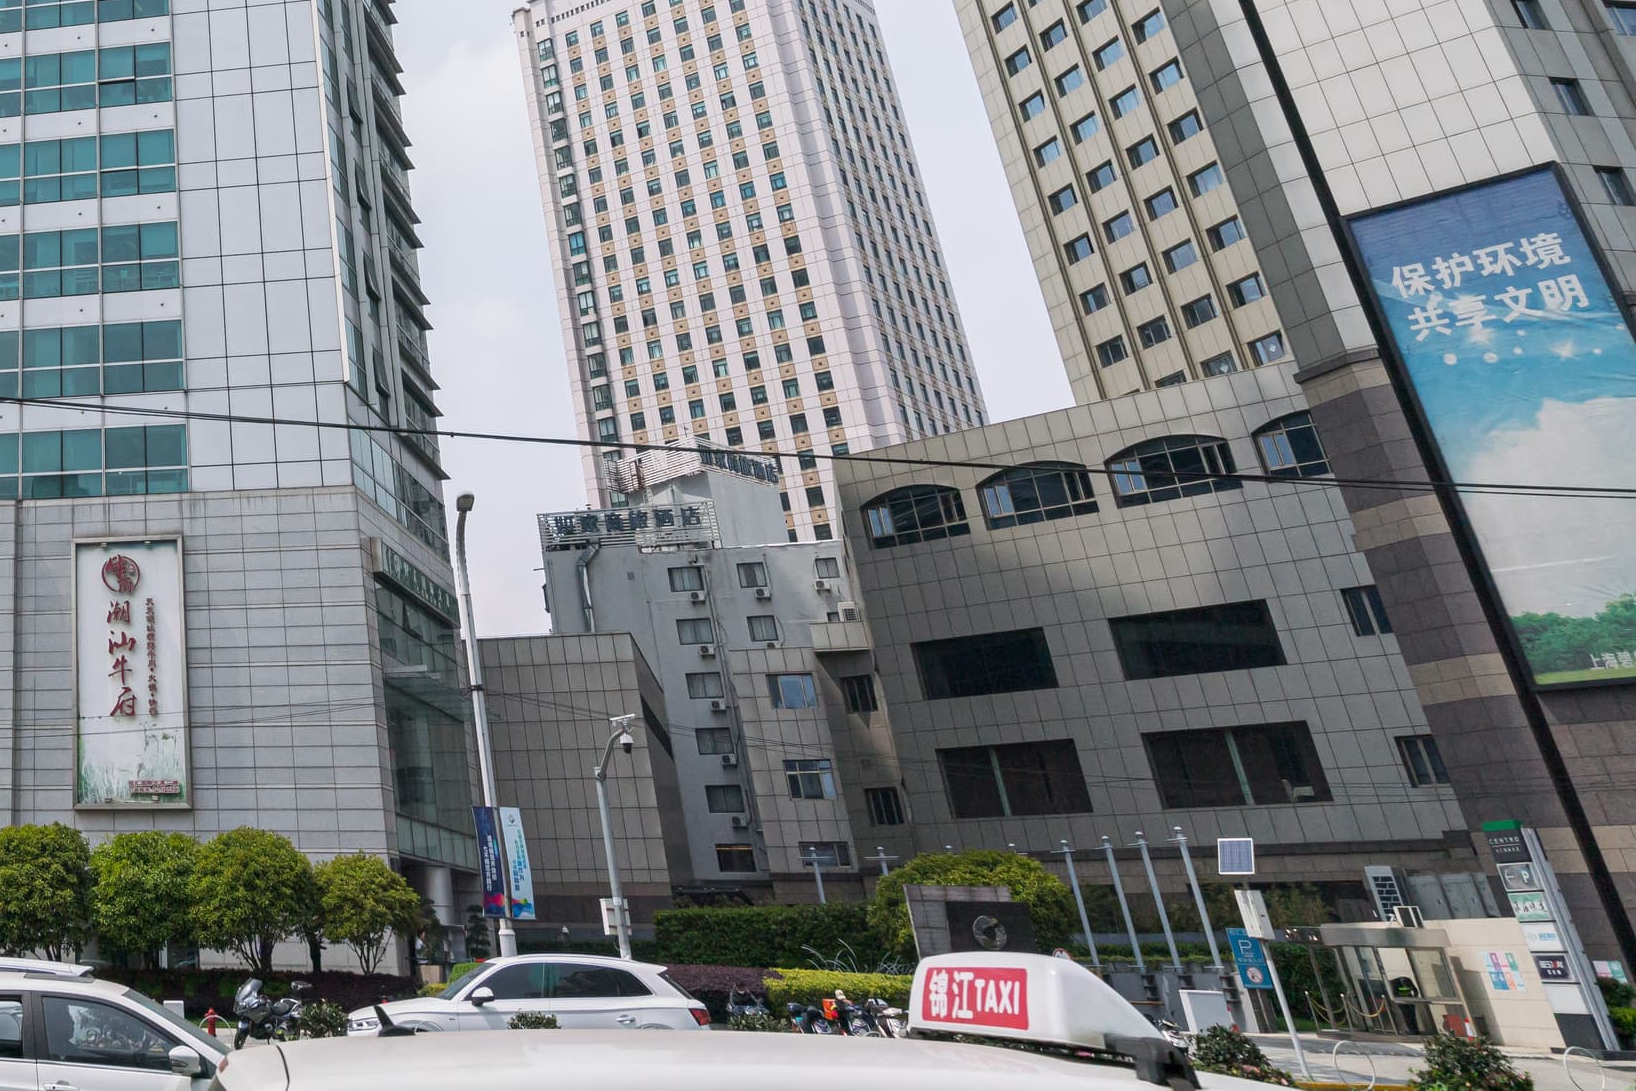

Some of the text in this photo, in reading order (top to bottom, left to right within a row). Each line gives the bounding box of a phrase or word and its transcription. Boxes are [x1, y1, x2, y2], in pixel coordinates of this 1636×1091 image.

[1391, 232, 1571, 299] 保护环境
[1407, 273, 1590, 342] 共享文明
[106, 600, 137, 717] 潮汕牛府
[1521, 870, 1530, 884] P
[1238, 939, 1252, 955] P
[974, 978, 1020, 1015] TAXI
